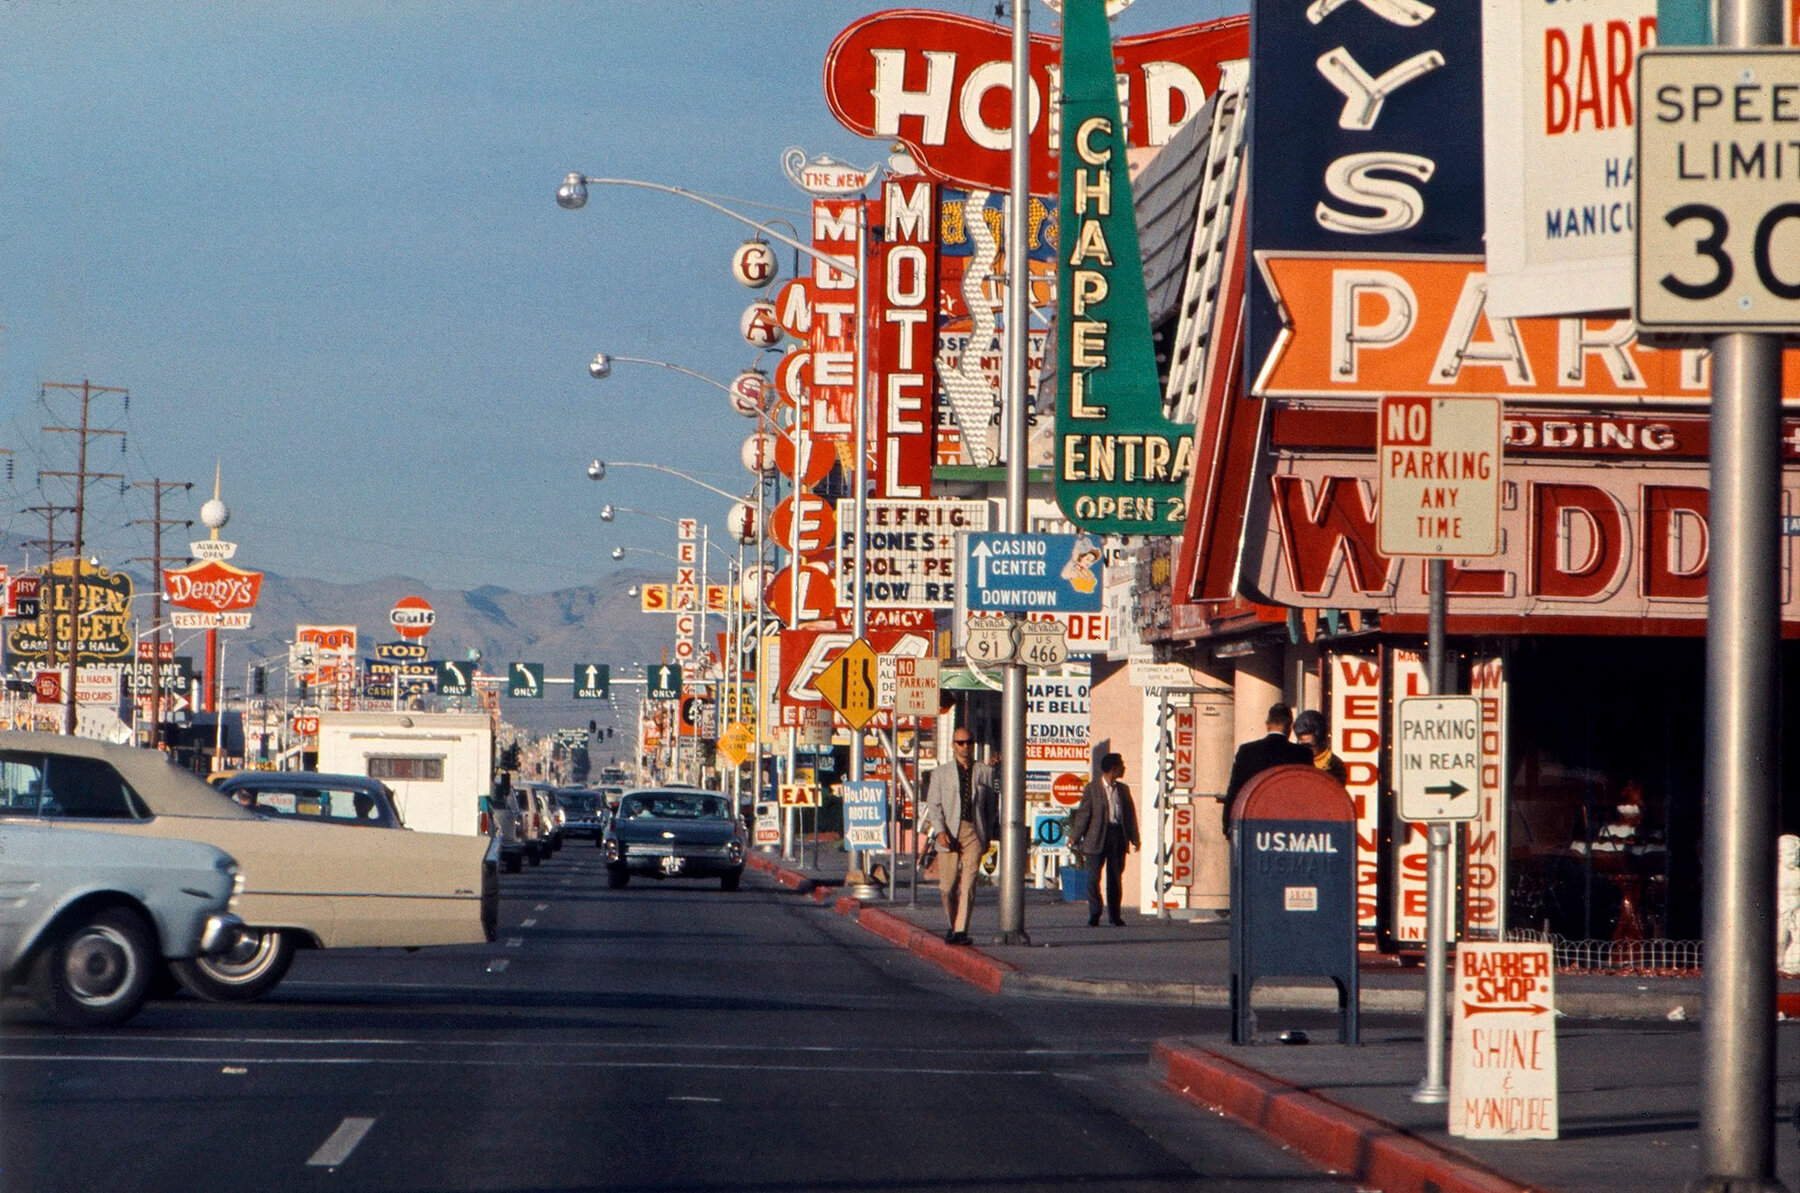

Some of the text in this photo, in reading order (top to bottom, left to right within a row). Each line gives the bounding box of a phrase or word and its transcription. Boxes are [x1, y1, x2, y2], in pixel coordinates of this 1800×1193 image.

[805, 172, 867, 187] THE NEW
[1071, 117, 1113, 419] CHAPEL
[814, 206, 858, 434] MOTEL
[885, 182, 932, 498] MOTEL
[1388, 403, 1427, 442] NO
[1391, 450, 1491, 481] PARKING
[1421, 488, 1458, 509] ANY
[1075, 495, 1154, 521] OPEN
[1418, 516, 1462, 540] TIME
[992, 540, 1047, 555] CASINO
[992, 560, 1047, 576] CENTER
[169, 573, 253, 609] Denny's
[676, 520, 693, 657] TEXACO
[982, 590, 1057, 606] DOWNTOWN
[174, 614, 249, 627] RESTAURANT
[391, 610, 434, 624] Gulf
[974, 619, 1006, 628] NEVADA
[1028, 624, 1060, 633] NEVADA
[379, 645, 426, 657] TOD
[978, 640, 998, 658] 91
[1029, 645, 1058, 662] 466
[371, 663, 434, 674] motor
[899, 660, 914, 675] NO
[443, 686, 467, 694] ONLY
[900, 678, 936, 688] PARKING
[514, 688, 538, 697] ONLY
[579, 690, 603, 698] ONLY
[652, 690, 677, 698] ONLY
[1403, 718, 1476, 741] PARKING
[1404, 753, 1477, 770] IN REAR
[782, 788, 821, 805] EAT
[848, 806, 880, 820] MOTEL
[851, 828, 883, 844] ENTRANCE
[1463, 952, 1550, 977] BARBER
[1477, 978, 1535, 1003] SHOP
[1472, 1028, 1544, 1070] SHINE
[1465, 1097, 1552, 1131] MANICURE
